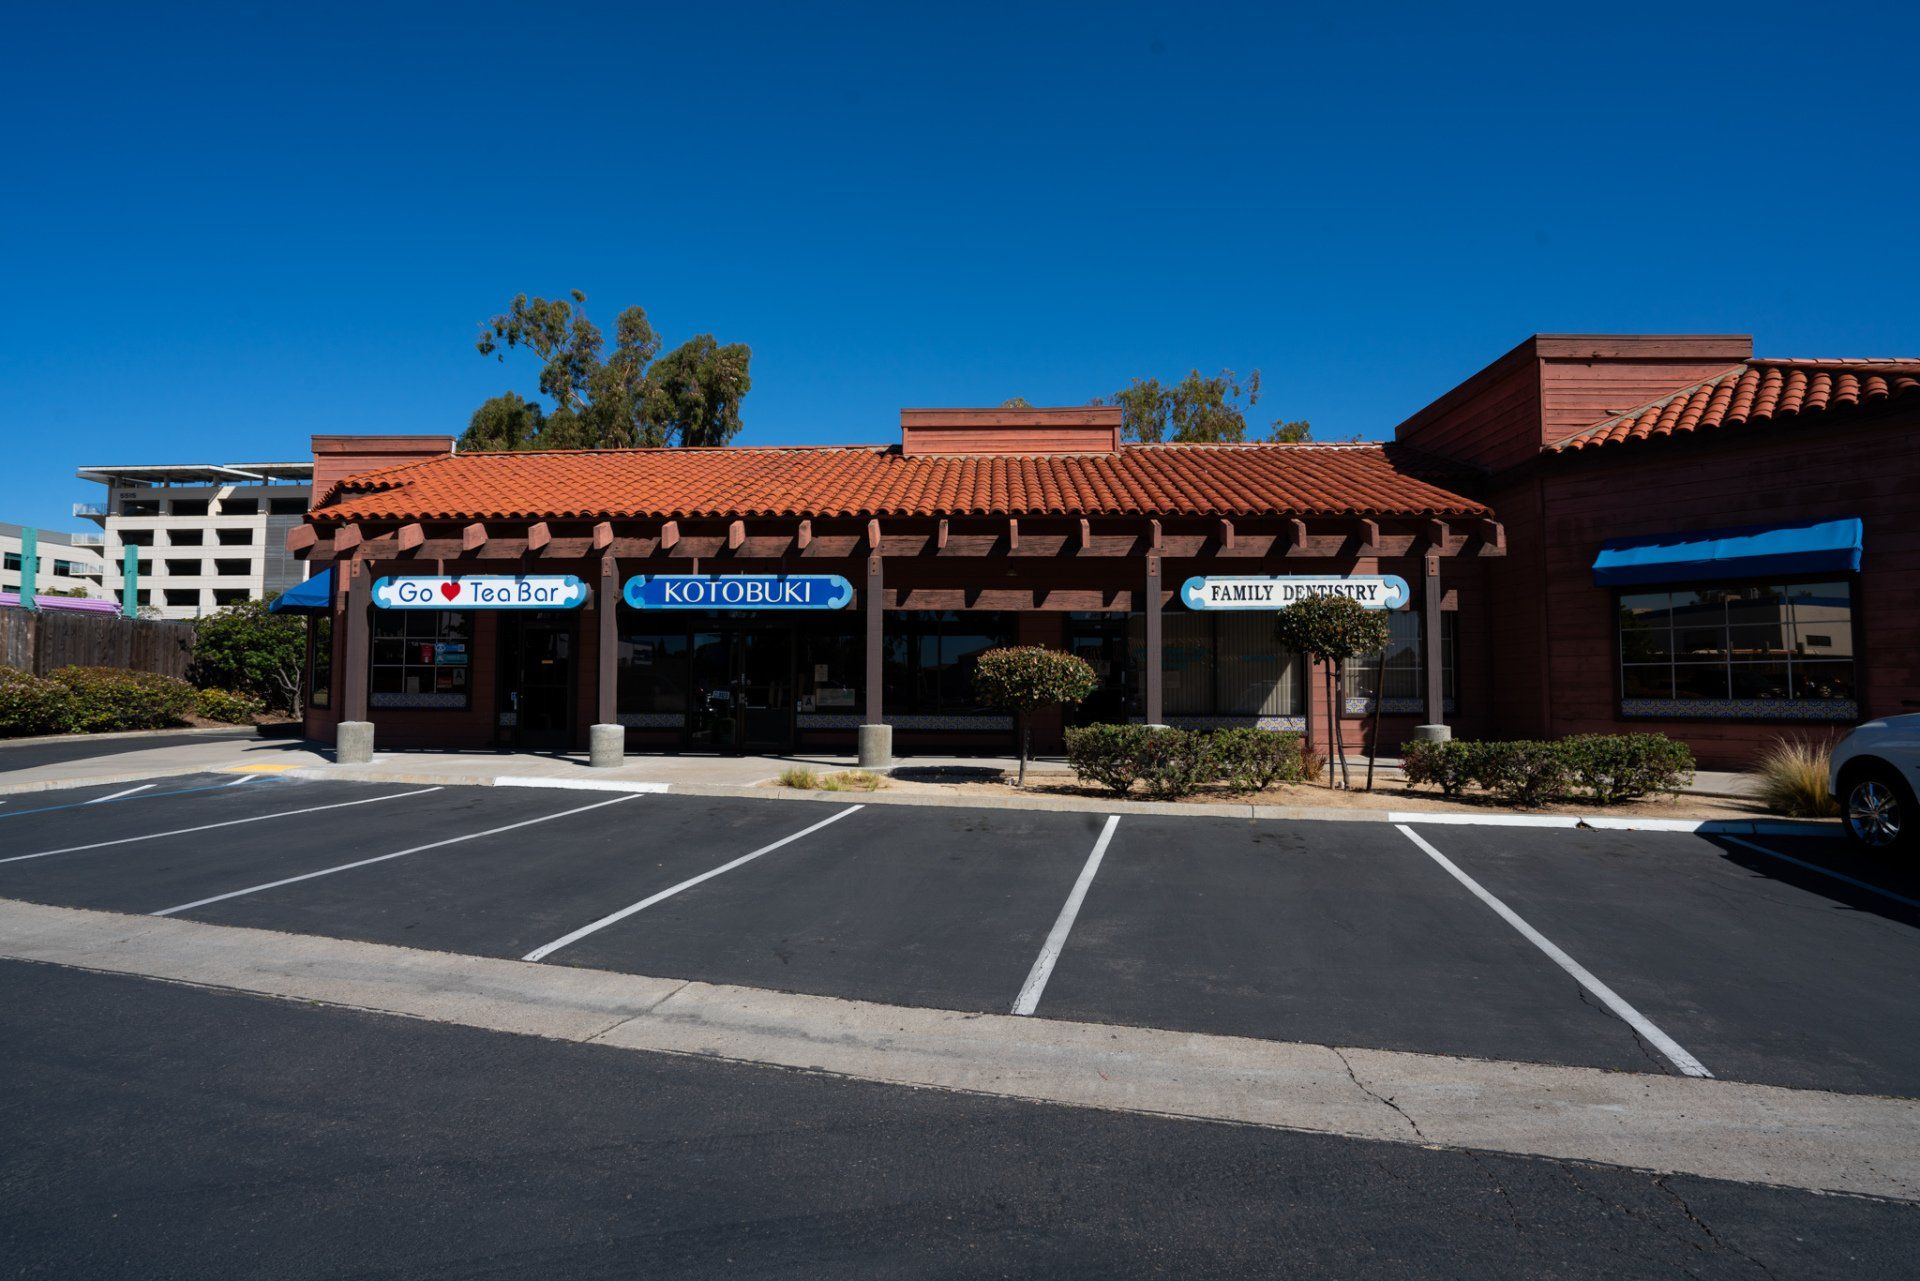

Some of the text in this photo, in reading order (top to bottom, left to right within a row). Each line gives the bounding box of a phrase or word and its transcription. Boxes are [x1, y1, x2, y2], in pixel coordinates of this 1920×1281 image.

[399, 581, 559, 602] Go Tea Bar
[665, 581, 811, 602] KOTOBUKI
[1211, 585, 1378, 601] FAMILY DENTISTRY
